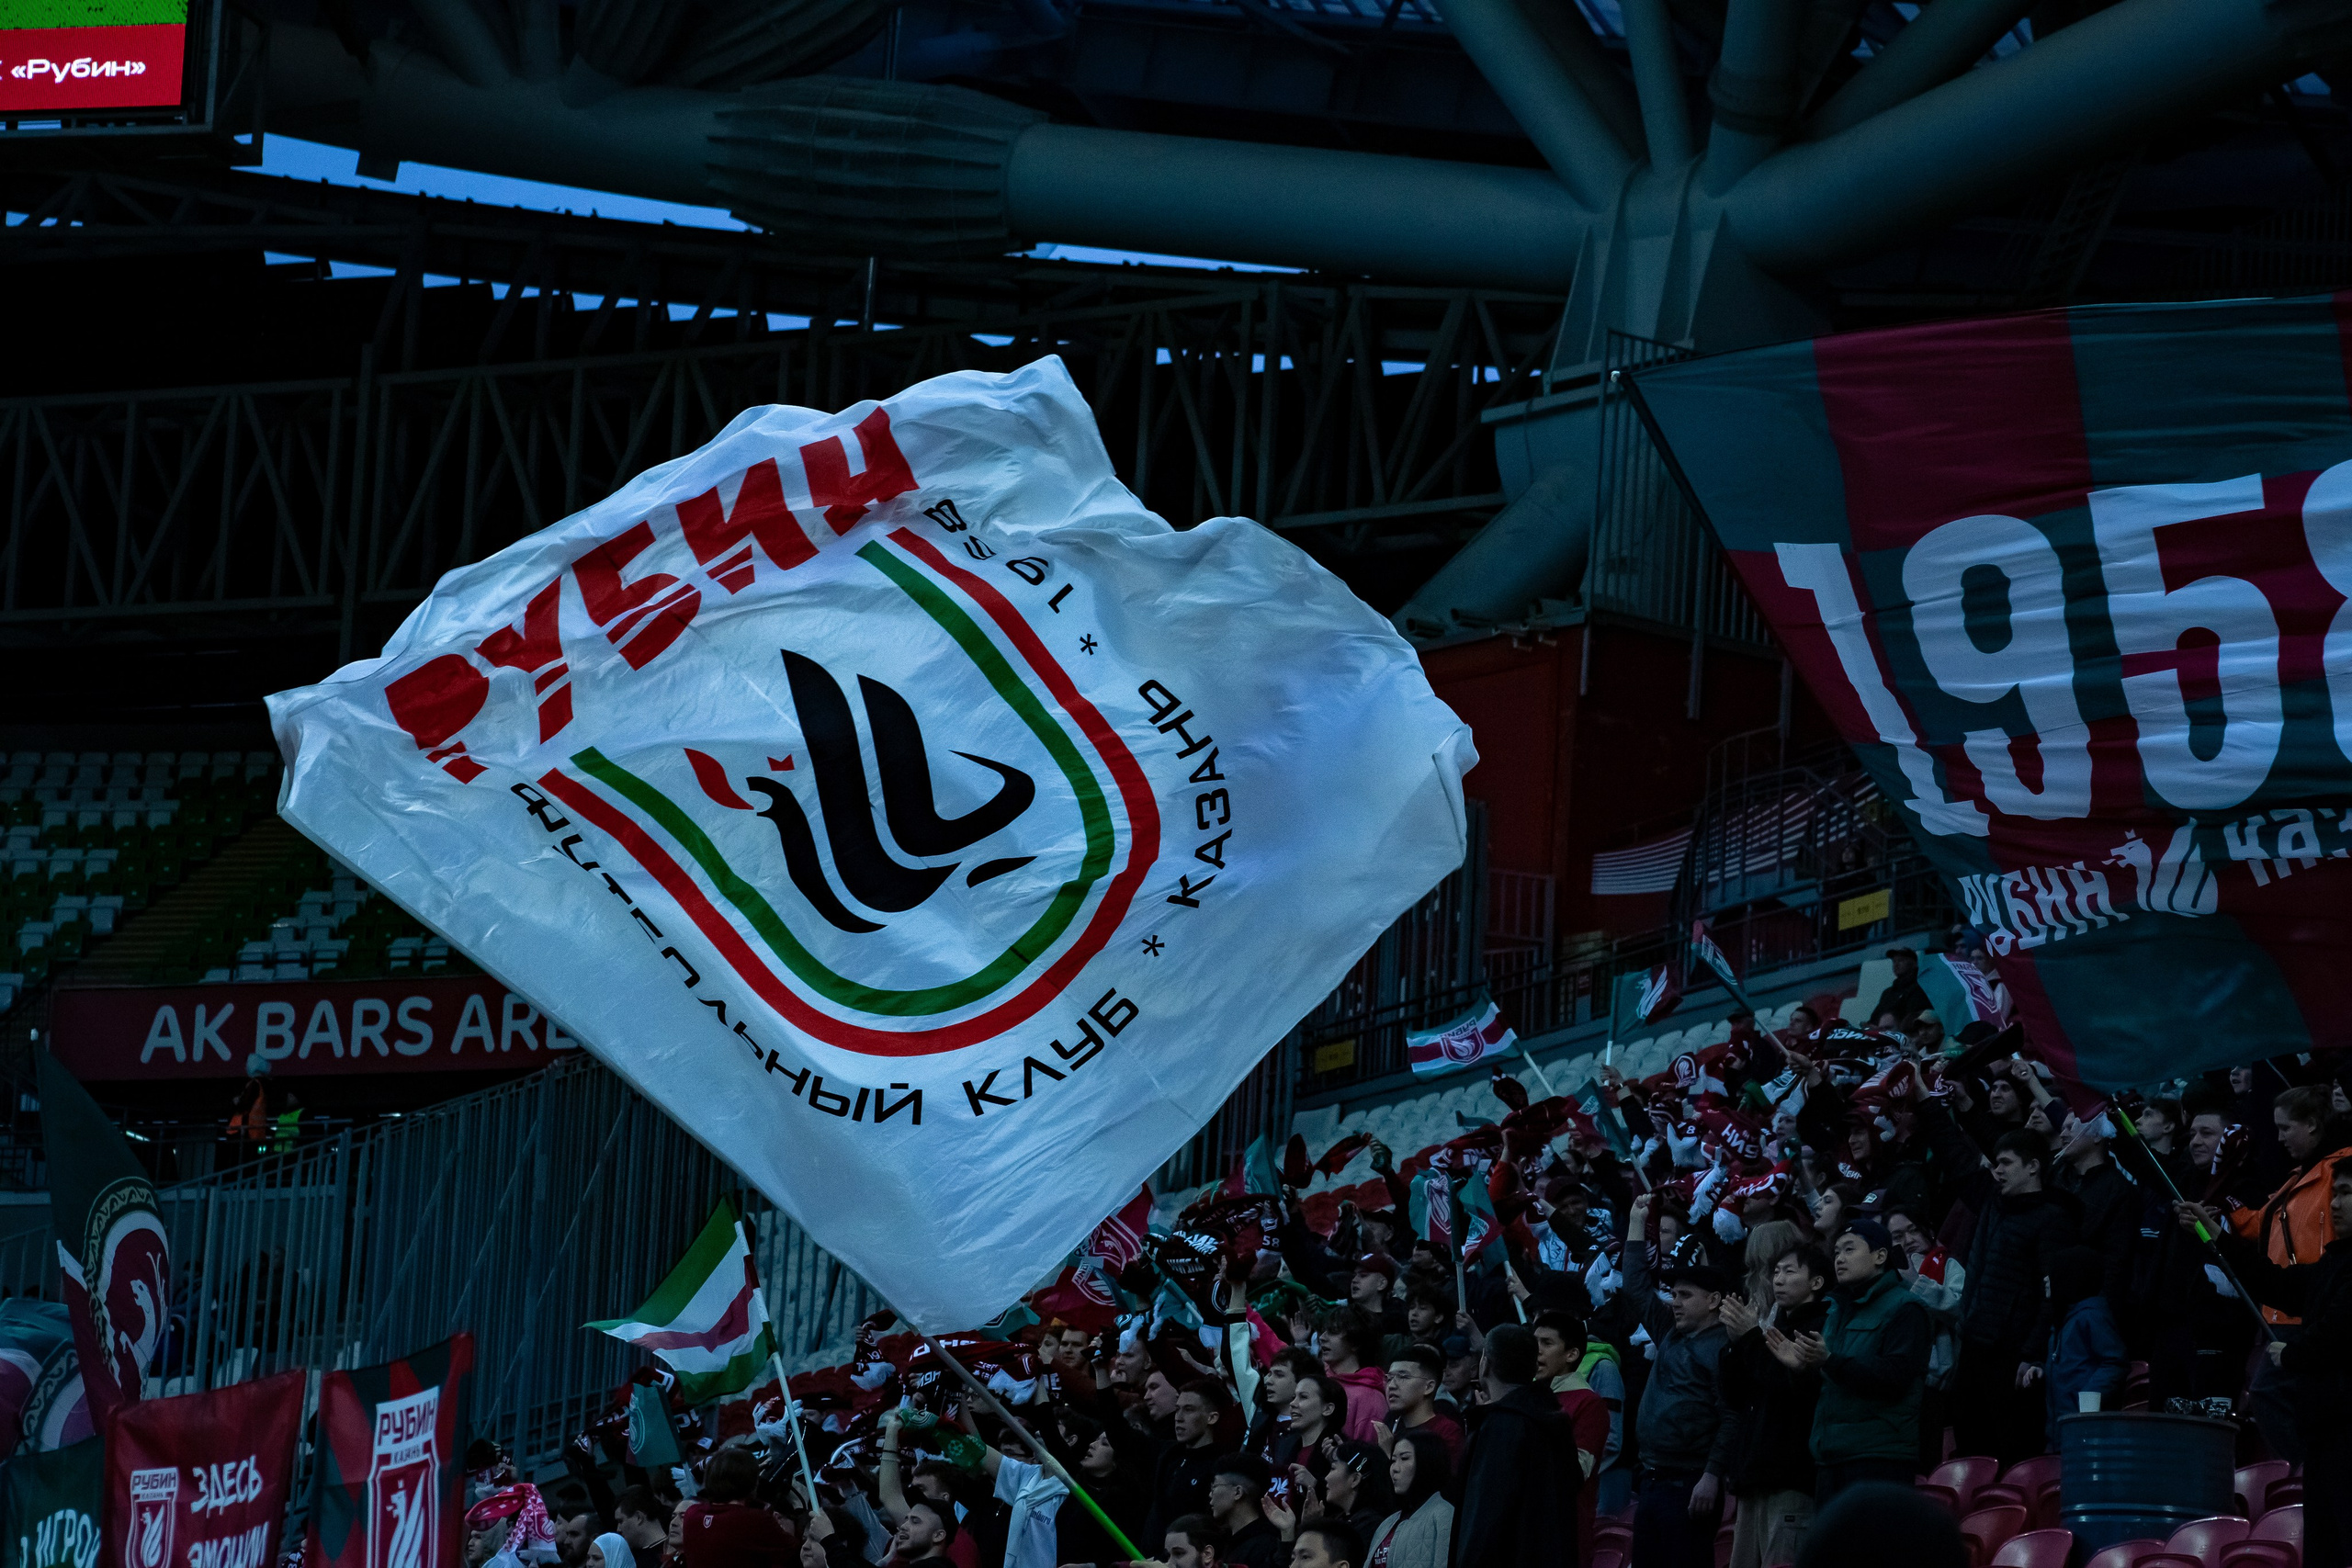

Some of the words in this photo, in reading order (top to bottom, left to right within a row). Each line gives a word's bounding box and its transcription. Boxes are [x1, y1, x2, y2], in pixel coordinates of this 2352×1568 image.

[10, 57, 146, 84] «Рубин»
[384, 405, 921, 784] РУБИН
[962, 987, 1140, 1117] КЛУБ
[1137, 679, 1233, 908] КАЗАНЬ
[1958, 861, 2130, 958] РУБИН
[141, 1003, 235, 1064] AK
[256, 995, 435, 1061] BARS
[378, 1398, 438, 1446] РУБИН
[131, 1472, 177, 1491] РУБИН
[190, 1454, 263, 1518] ЗДЕСЬ
[187, 1520, 269, 1568] ЭМОЦИИ
